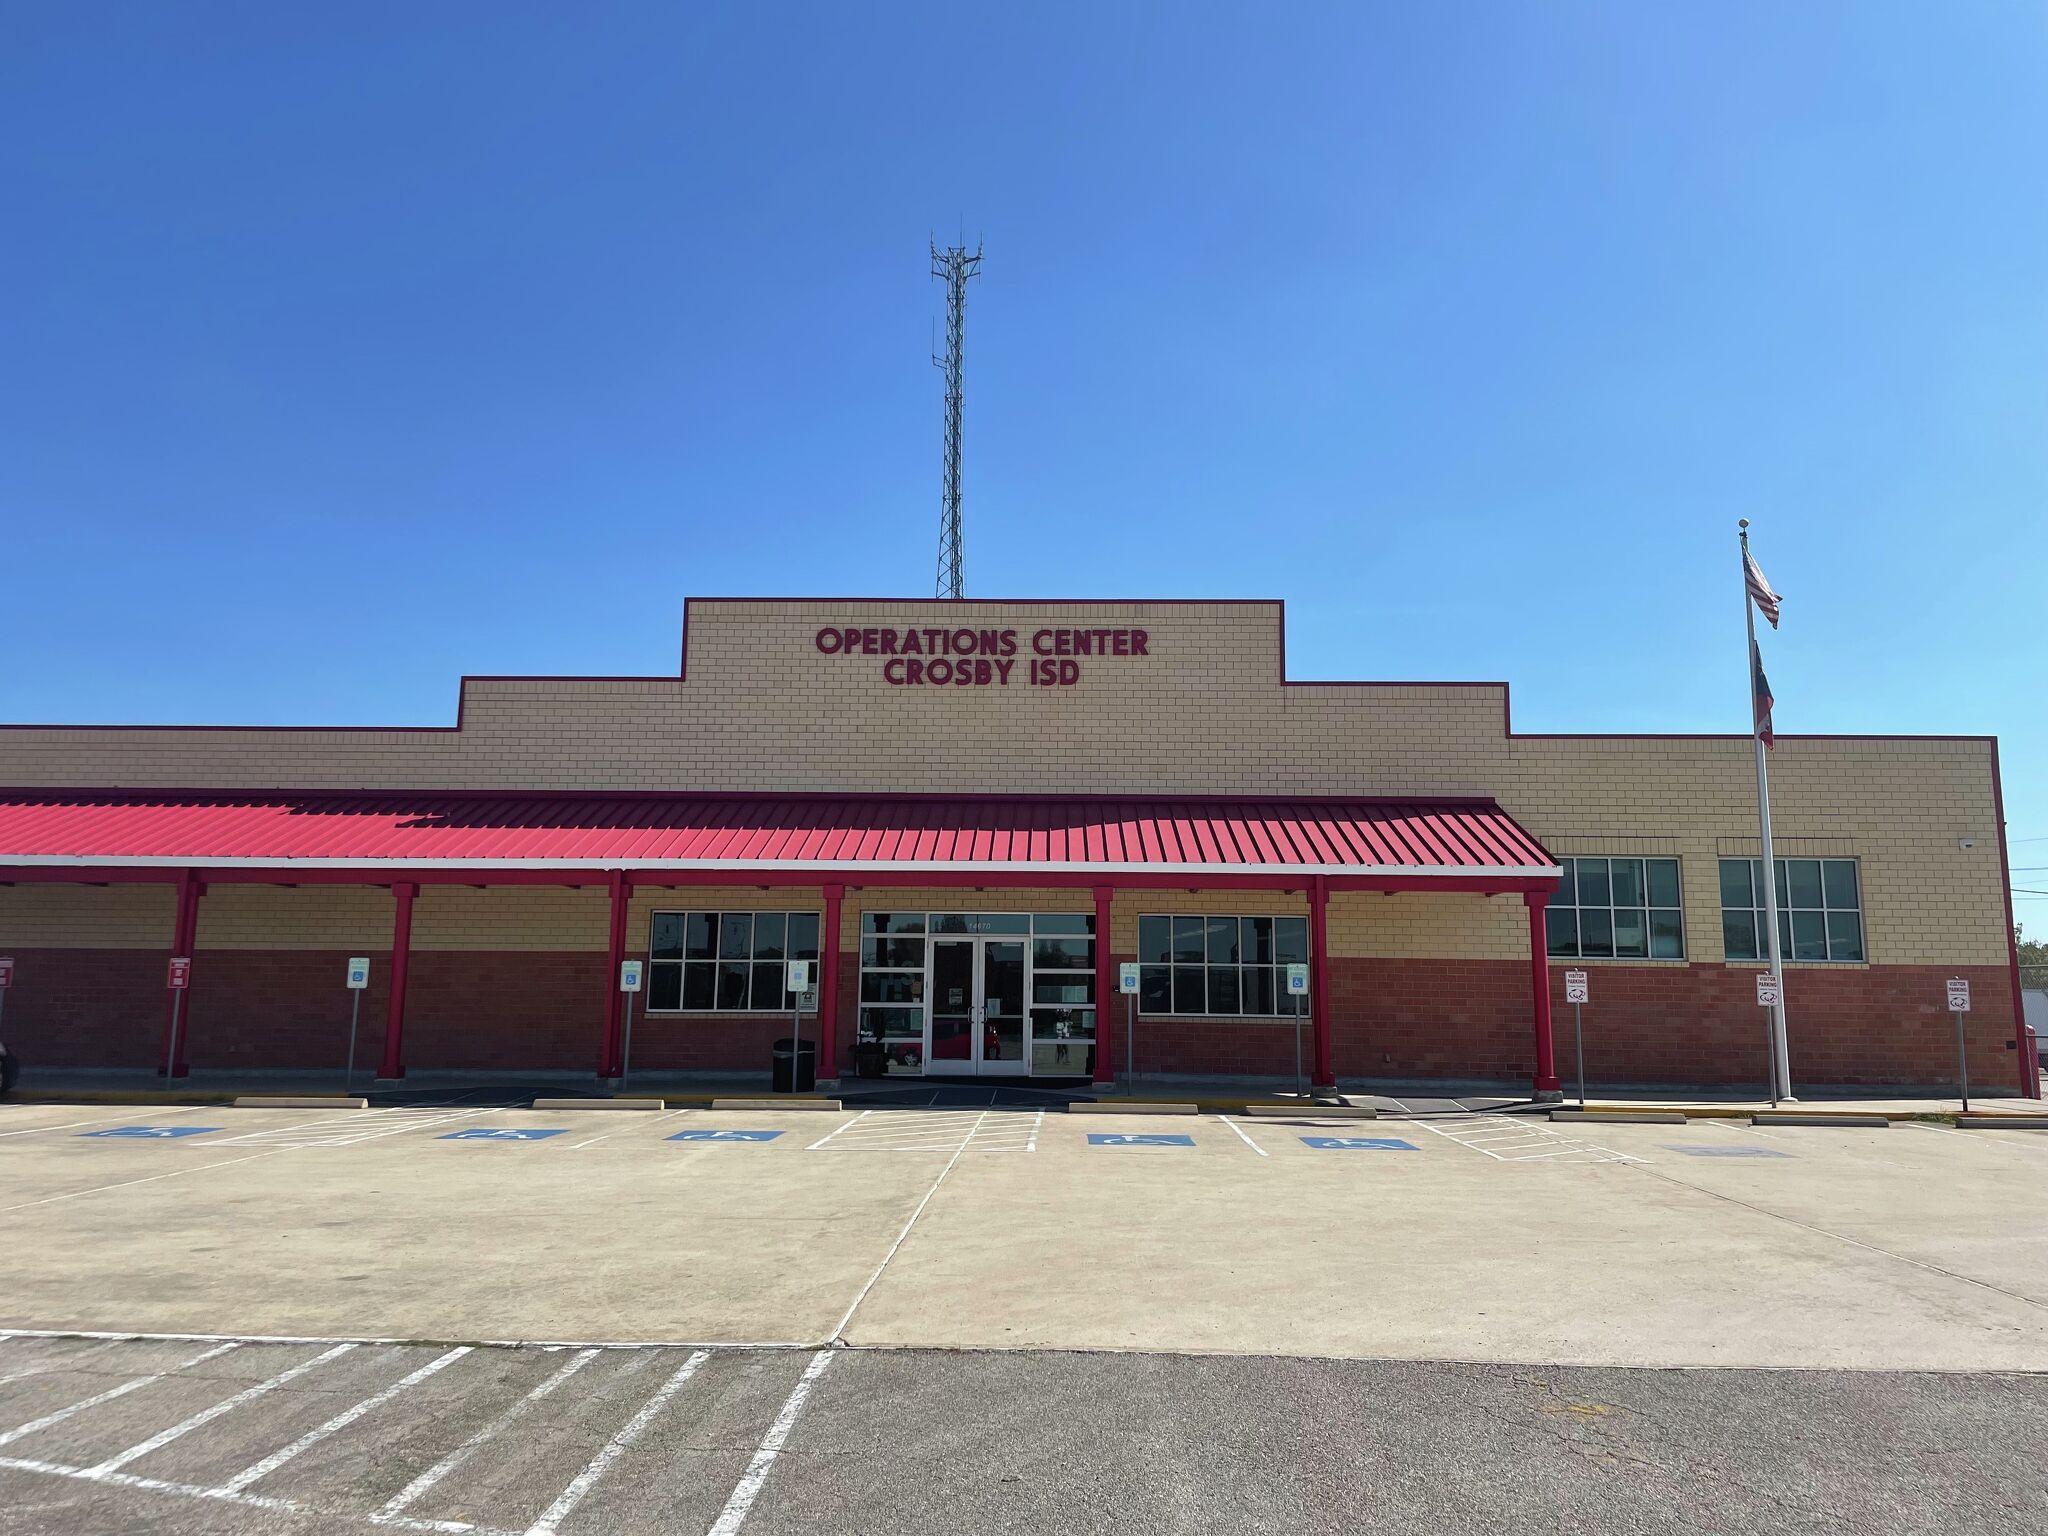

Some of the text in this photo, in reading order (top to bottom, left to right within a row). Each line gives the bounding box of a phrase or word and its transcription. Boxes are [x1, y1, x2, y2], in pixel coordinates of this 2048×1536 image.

[815, 627, 1149, 656] OPERATIONS CENTER
[884, 658, 1080, 686] CROSBY ISD
